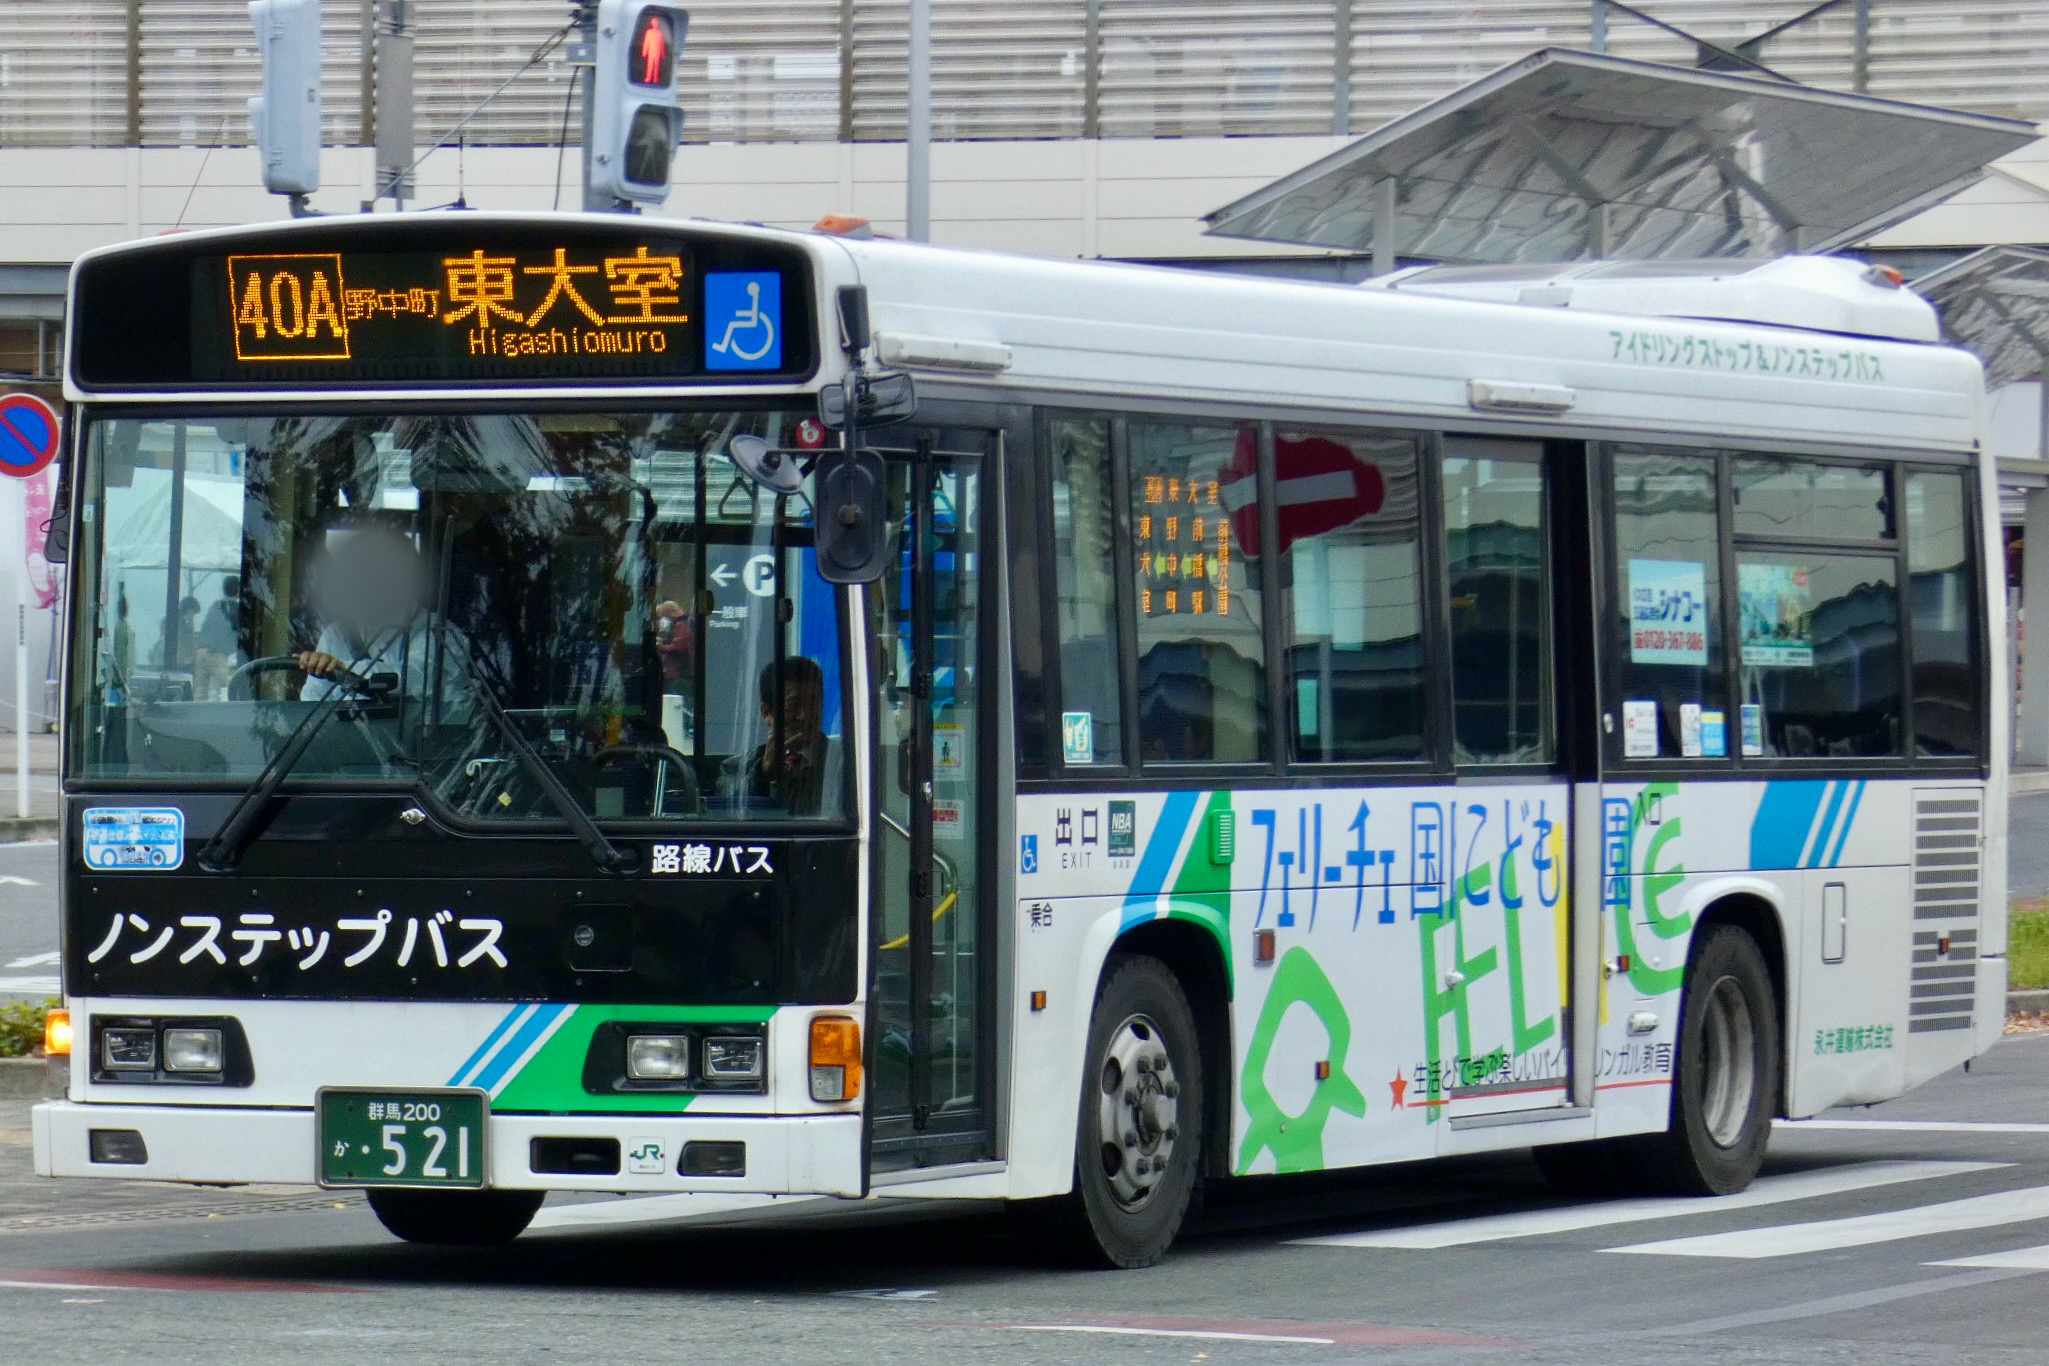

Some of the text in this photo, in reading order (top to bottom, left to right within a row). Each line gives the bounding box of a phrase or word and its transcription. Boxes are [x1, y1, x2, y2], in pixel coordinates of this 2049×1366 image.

[443, 247, 688, 328] 東大室
[239, 270, 343, 338] 40A
[345, 288, 440, 319] 野中町
[469, 327, 666, 357] Higashiomuro
[1055, 807, 1099, 847] 出口
[1111, 812, 1132, 831] NBA
[651, 843, 774, 874] 路線バス
[1061, 851, 1092, 870] EXIT
[87, 907, 509, 971] ノンステップバス
[333, 1140, 350, 1158] か
[631, 1144, 660, 1160] JR
